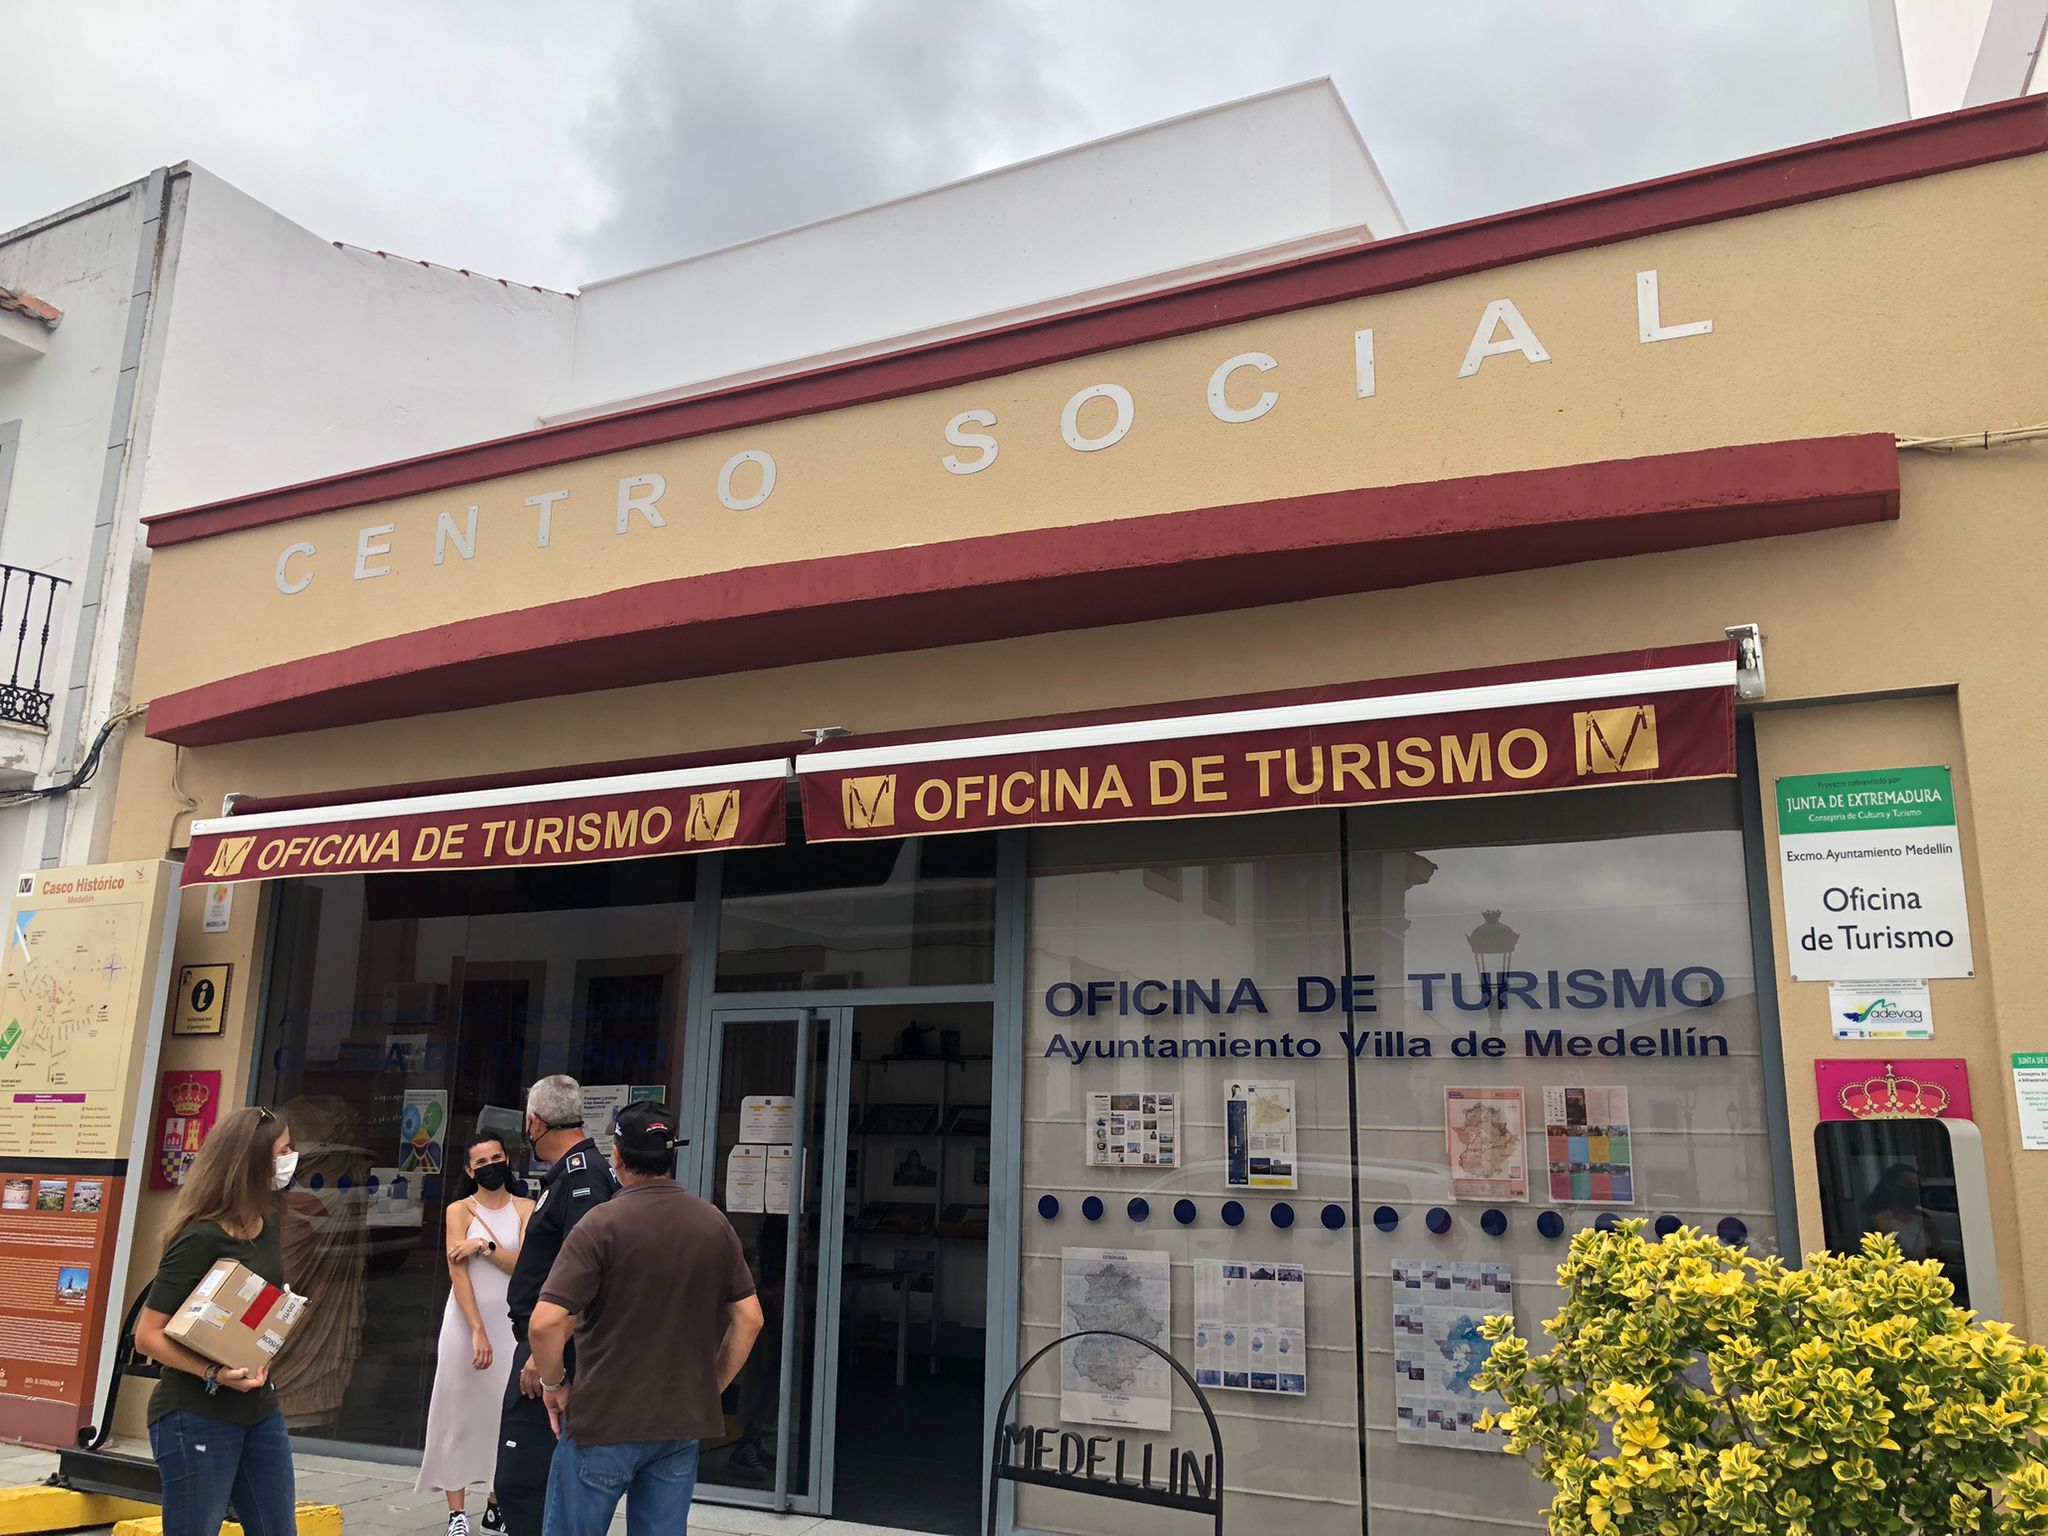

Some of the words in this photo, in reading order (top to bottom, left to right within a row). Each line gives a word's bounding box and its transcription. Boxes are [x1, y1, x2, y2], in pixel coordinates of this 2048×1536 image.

[275, 450, 777, 595] CENTRO
[940, 269, 1714, 475] SOCIAL
[914, 764, 1133, 821] OFICINA
[1149, 755, 1228, 806] DE
[1245, 727, 1549, 797] TURISMO
[1787, 796, 1826, 812] JUNTA
[1829, 794, 1844, 808] DE
[1848, 788, 1942, 807] EXTREMADURA
[1847, 812, 1856, 820] de
[1857, 810, 1885, 819] Cultura
[1886, 811, 1891, 819] y
[1893, 808, 1922, 818] Turismo
[257, 829, 401, 871] OFICINA
[411, 823, 465, 863] DE
[481, 805, 673, 858] TURISMO
[1826, 847, 1901, 864] Ayuntamiento
[1905, 843, 1953, 856] Medellín
[42, 881, 73, 896] Casco
[75, 876, 125, 892] Histórico
[1823, 886, 1922, 912] Oficina
[1801, 926, 1833, 951] de
[1838, 925, 1954, 950] Turismo
[1045, 977, 1269, 1017] OFICINA
[1297, 975, 1377, 1014] DE
[1407, 966, 1725, 1011] TURISMO
[1870, 1008, 1923, 1023] adevag
[1044, 1031, 1321, 1065] Ayuntamiento
[1338, 1030, 1432, 1058] Villa
[1449, 1030, 1506, 1057] de
[1524, 1027, 1729, 1057] Medellín
[1001, 1421, 1213, 1500] MEDELLIN
